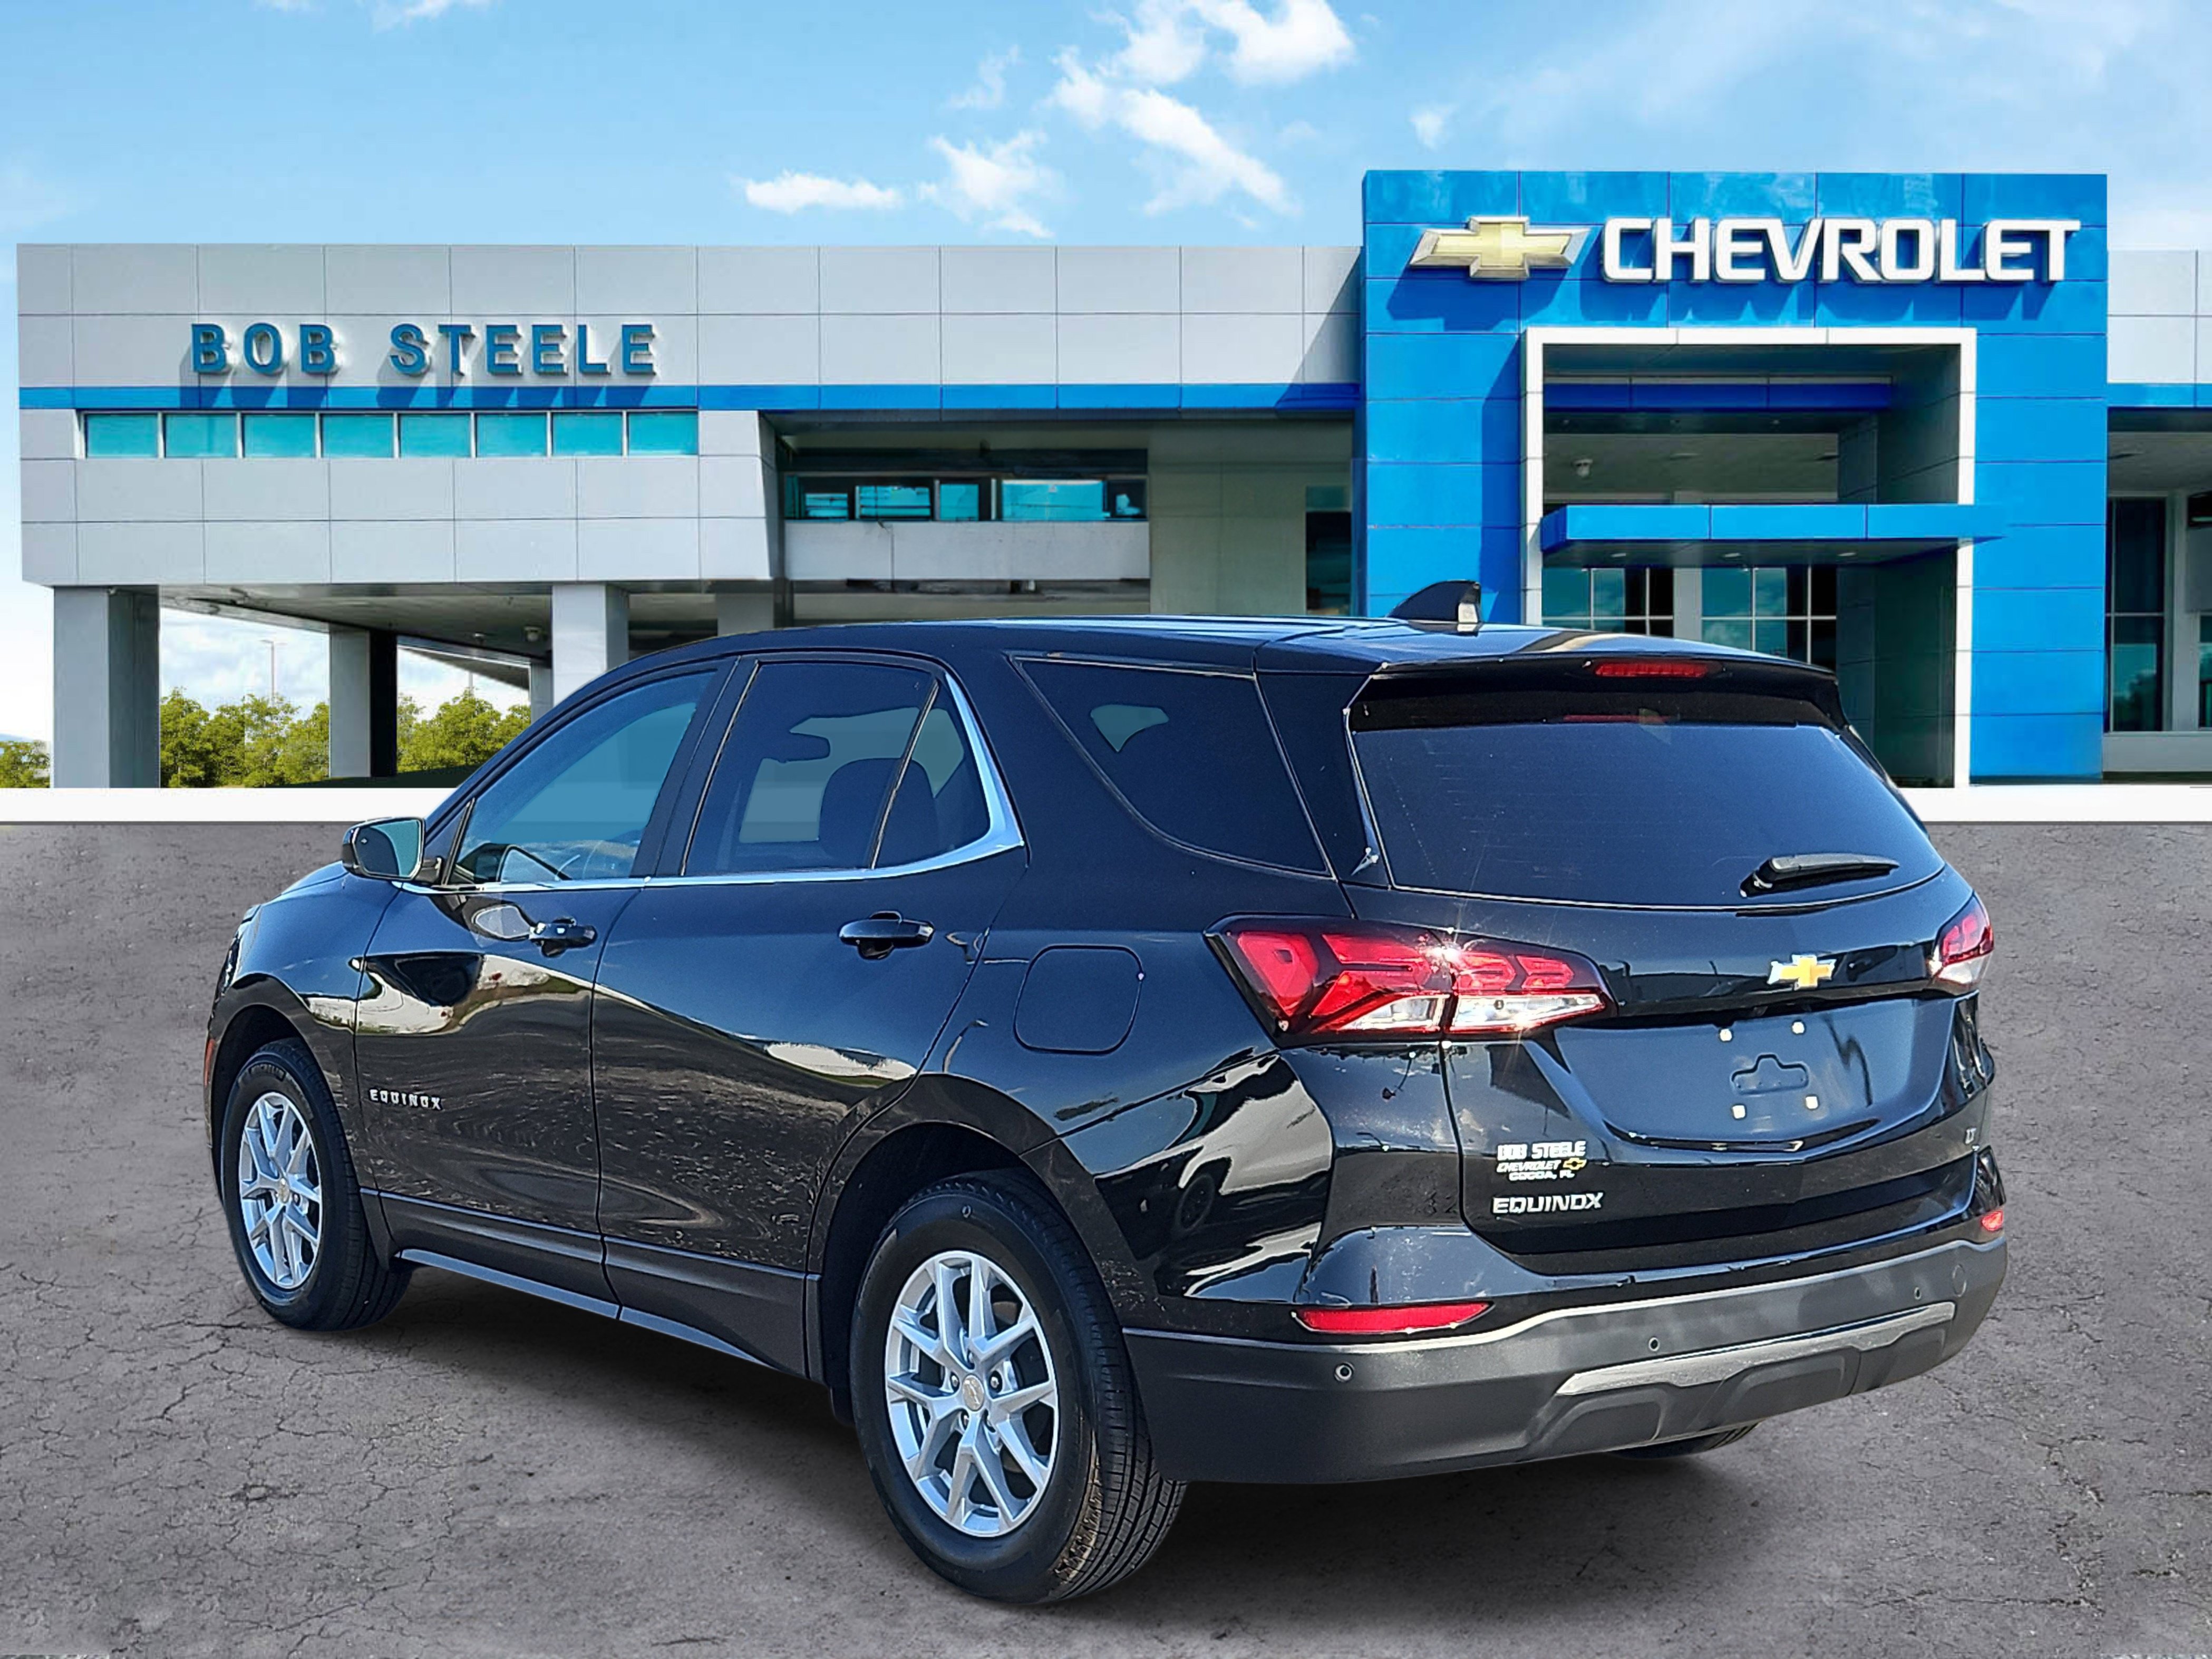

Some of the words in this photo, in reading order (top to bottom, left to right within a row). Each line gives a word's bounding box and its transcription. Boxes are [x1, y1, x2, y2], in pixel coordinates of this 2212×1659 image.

[1602, 217, 2081, 284] CHEVROLET
[191, 323, 338, 374] BOB
[389, 323, 657, 376] STEELE
[370, 1089, 441, 1110] EQUINOX
[1498, 1143, 1528, 1161] BOB
[1531, 1141, 1586, 1159] STEELE
[1496, 1160, 1561, 1172] CHEVROLET
[1492, 1192, 1604, 1214] EQUINOX
